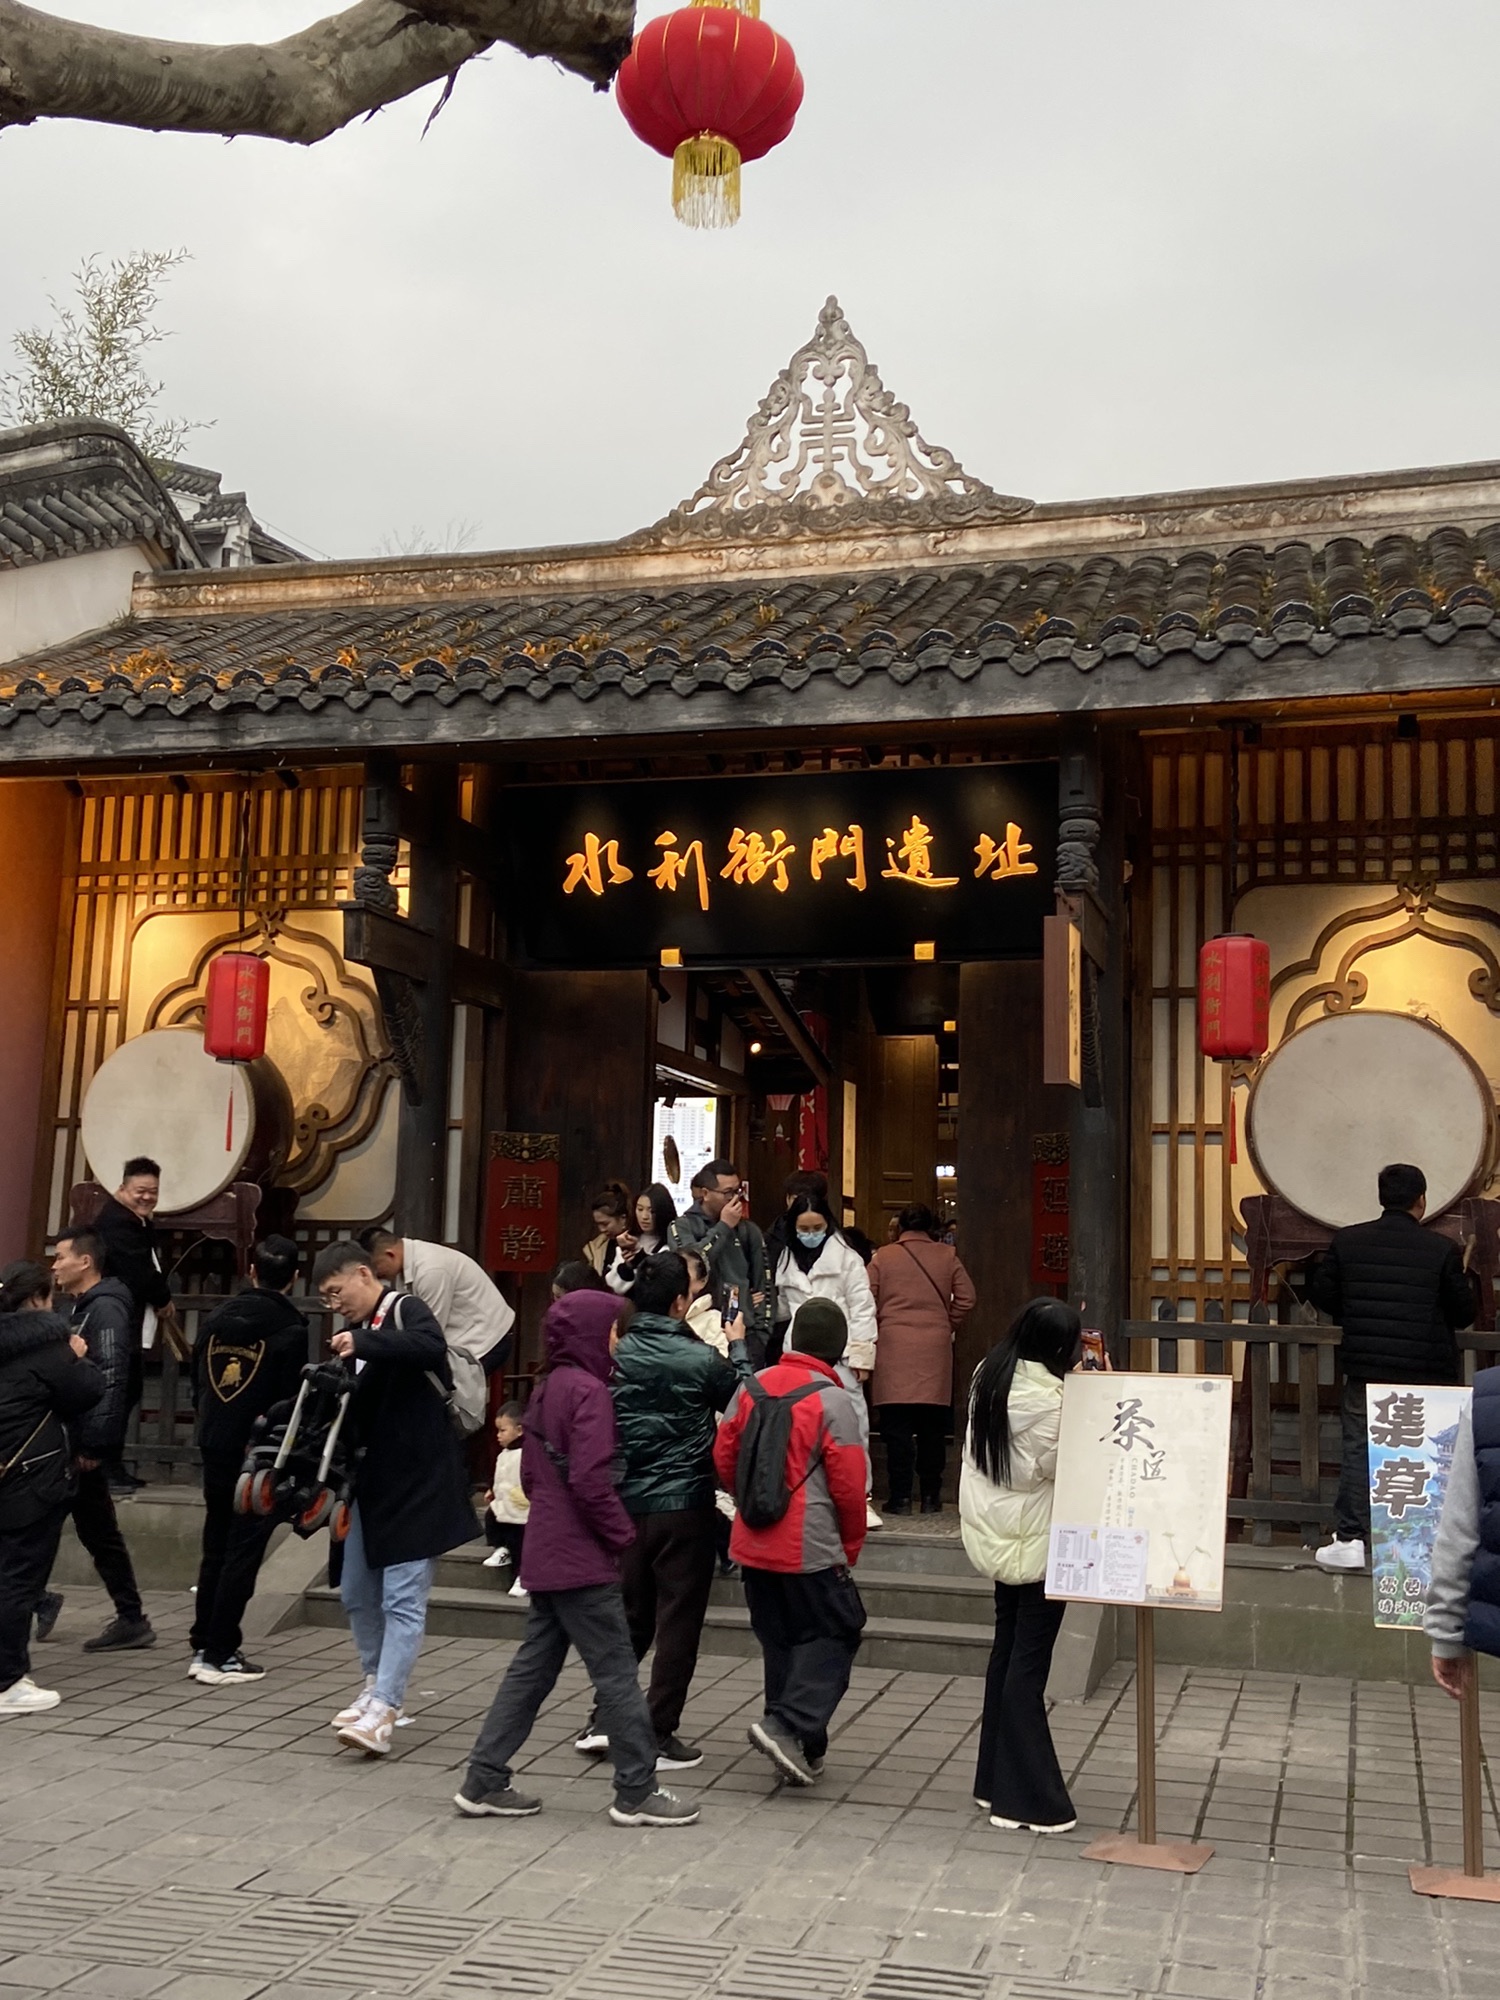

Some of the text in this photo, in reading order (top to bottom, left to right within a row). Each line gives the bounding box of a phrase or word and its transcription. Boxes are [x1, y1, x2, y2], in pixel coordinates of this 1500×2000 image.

[562, 815, 1038, 911] 水利衙門遺址
[1099, 1398, 1167, 1482] 茶道
[1129, 1457, 1138, 1499] CHADAO
[1370, 1391, 1431, 1517] 集章
[1379, 1575, 1430, 1596] 需要
